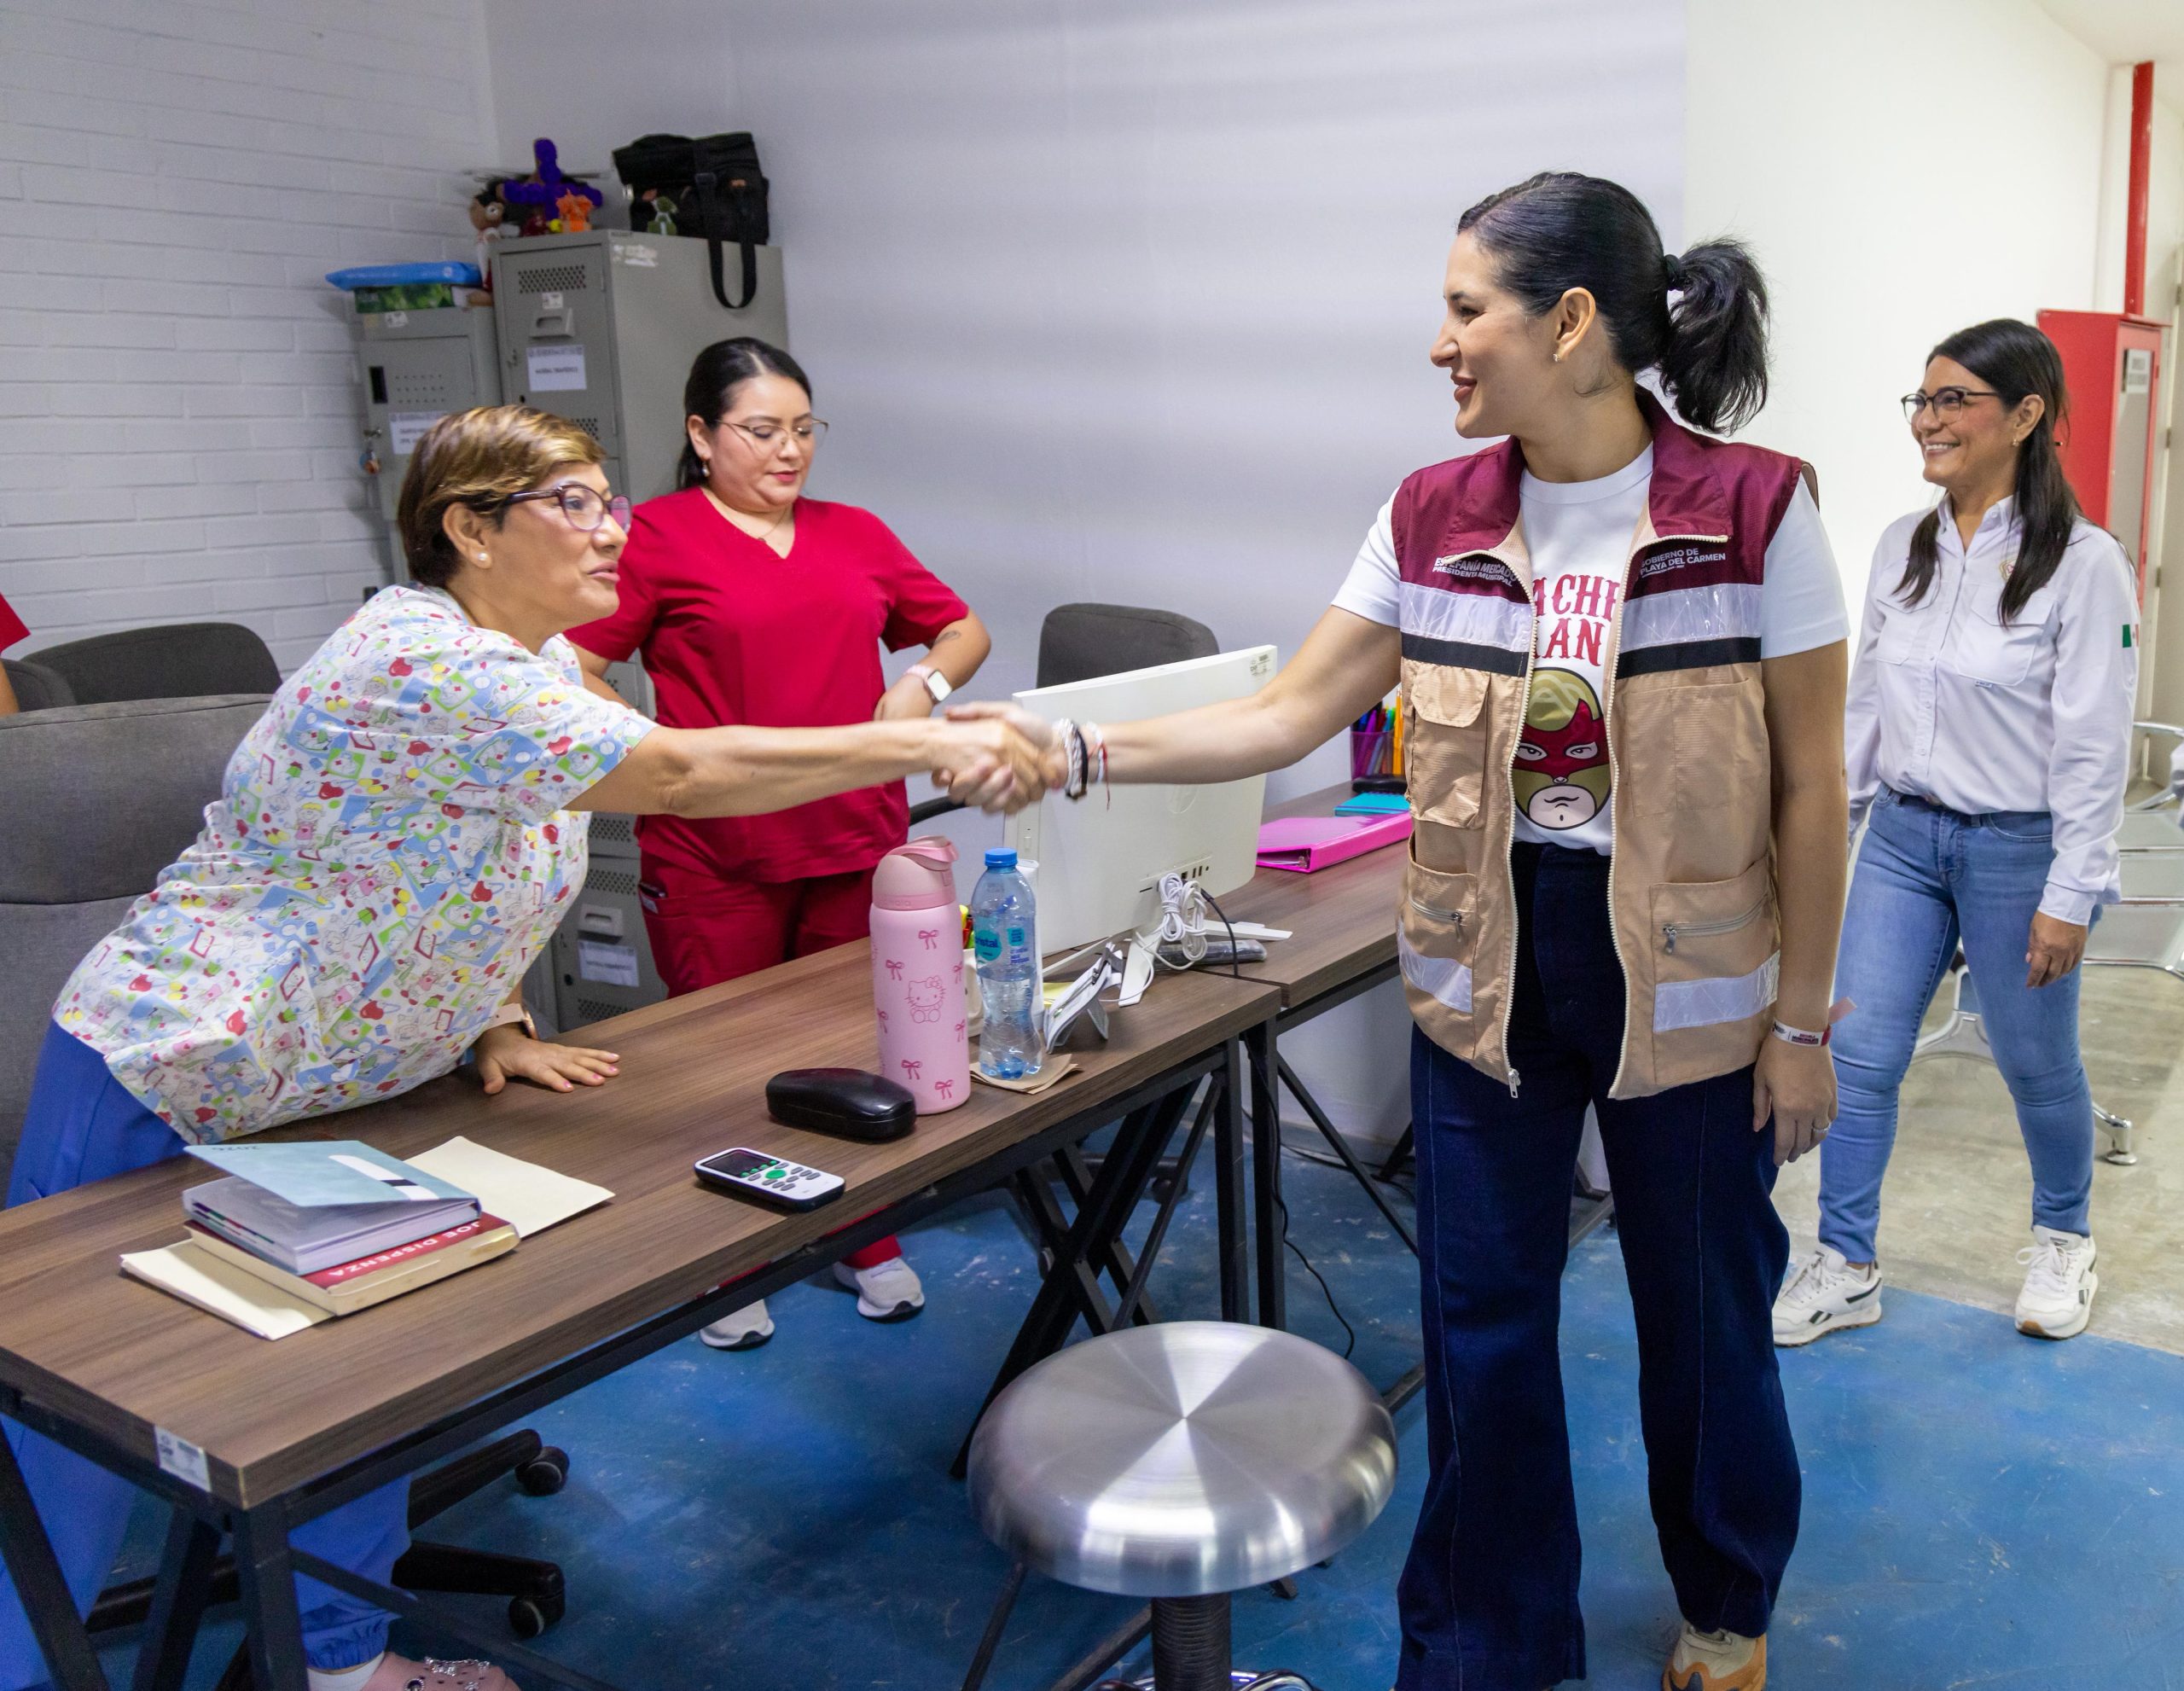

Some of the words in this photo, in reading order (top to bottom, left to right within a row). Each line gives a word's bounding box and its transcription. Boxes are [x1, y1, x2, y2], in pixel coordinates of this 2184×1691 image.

[1686, 548, 1699, 556] DE
[1640, 562, 1668, 575] PLAYA
[1668, 557, 1686, 567] DEL
[1687, 553, 1726, 564] CARMEN
[442, 1221, 480, 1239] JOE
[328, 1238, 439, 1277] DISPENZA
